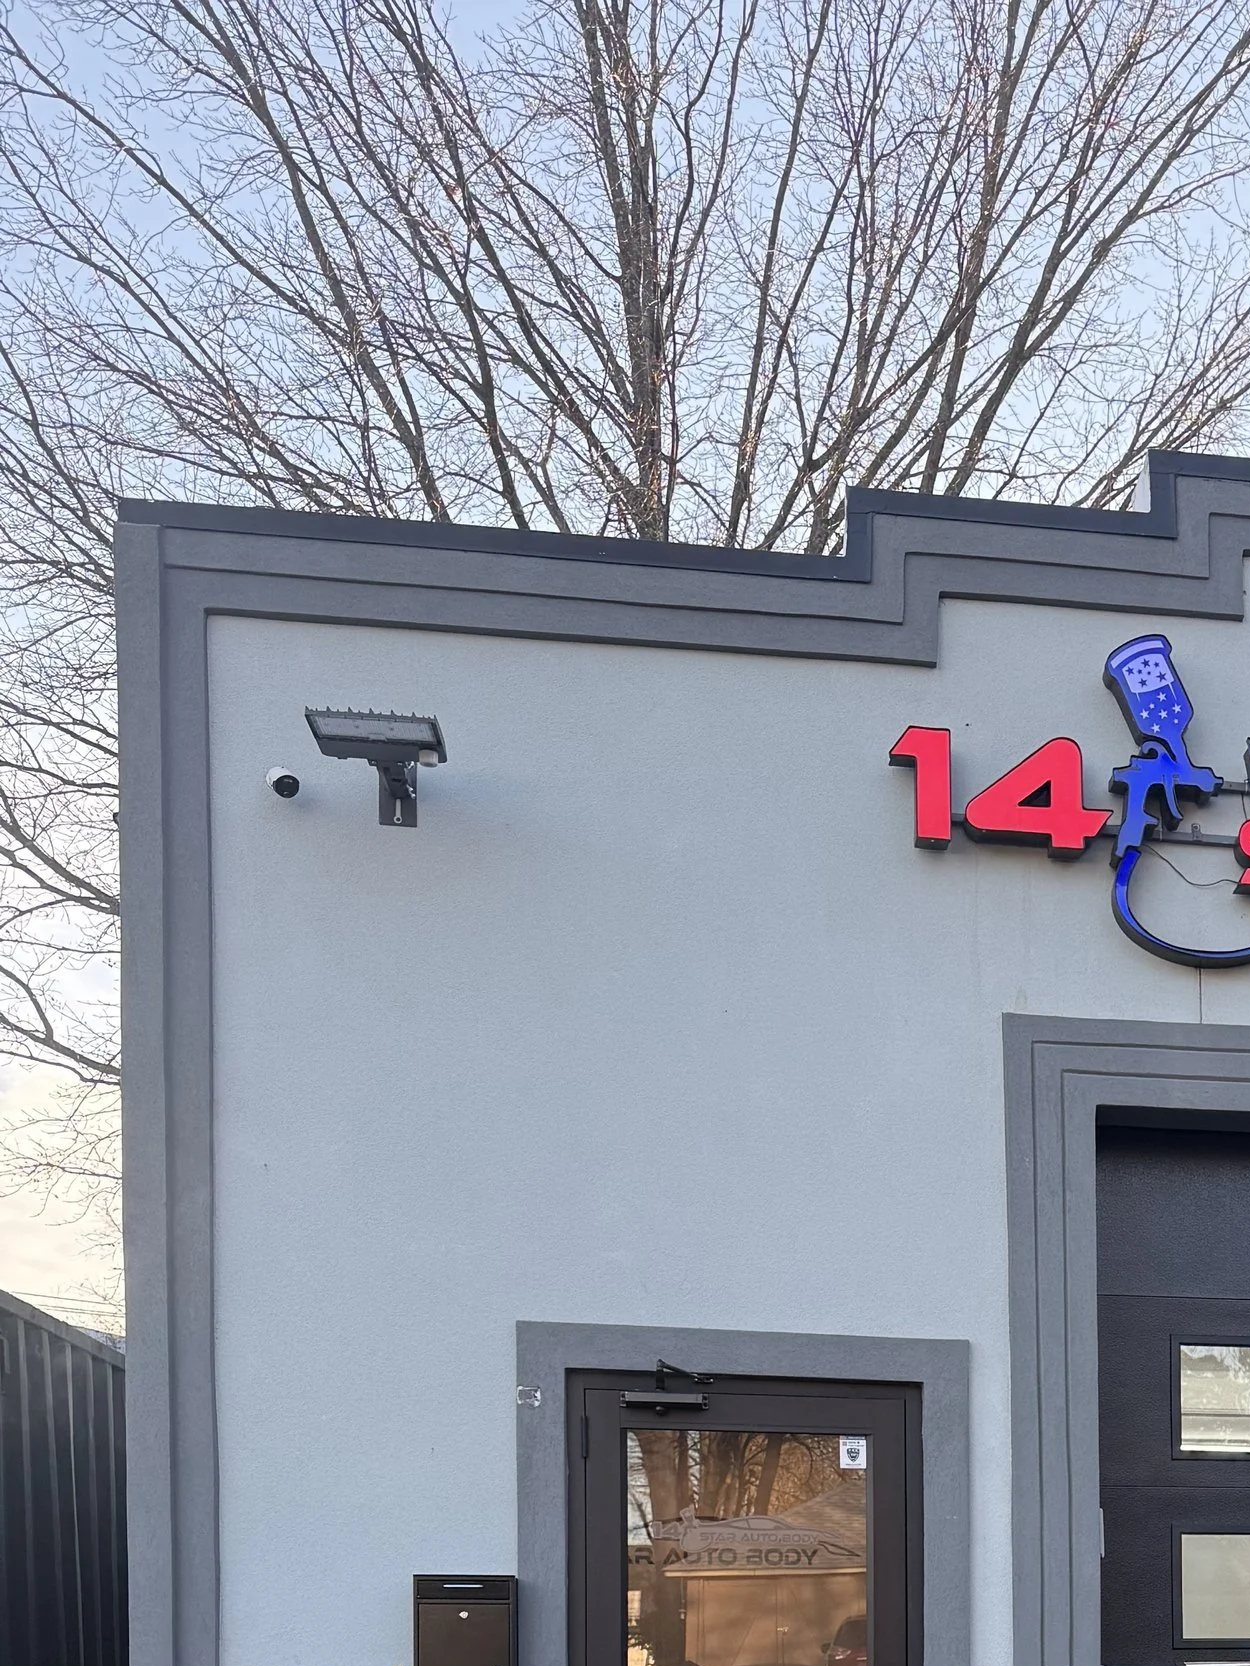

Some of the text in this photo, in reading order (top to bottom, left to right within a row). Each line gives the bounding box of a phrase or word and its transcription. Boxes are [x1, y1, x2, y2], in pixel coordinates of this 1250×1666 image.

[889, 725, 1113, 858] 14
[652, 1520, 682, 1540] 14
[699, 1532, 819, 1545] STAR AUTO BODY
[663, 1548, 738, 1566] AUTO
[746, 1548, 818, 1566] BODY
